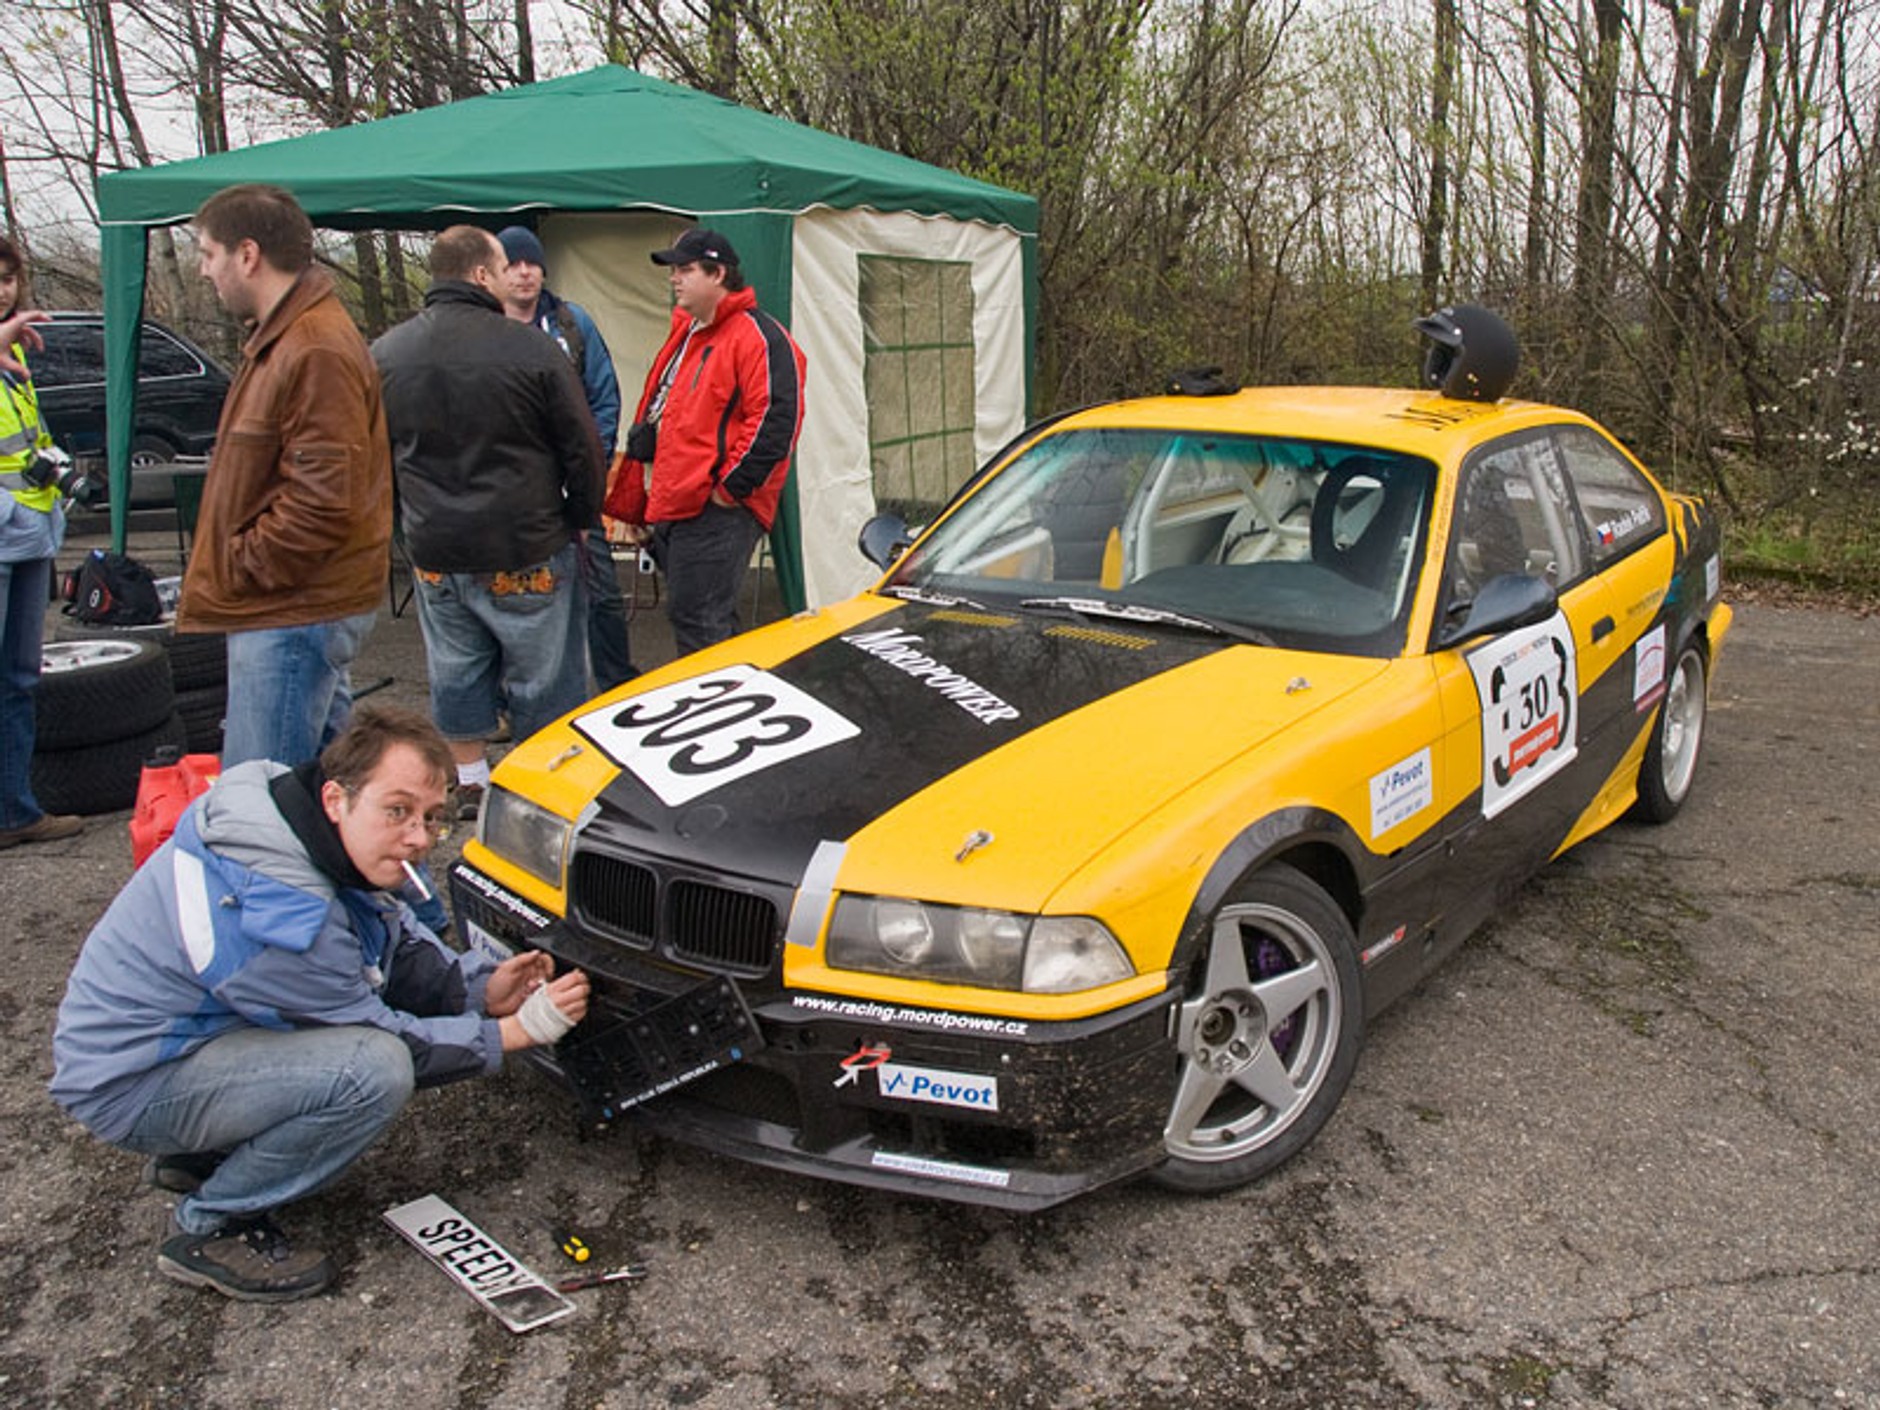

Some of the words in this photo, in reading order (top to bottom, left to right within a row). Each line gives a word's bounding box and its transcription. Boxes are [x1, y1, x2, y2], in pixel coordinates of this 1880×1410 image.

[612, 679, 812, 775] 303
[793, 995, 1029, 1036] www.racing.mordpower.cz
[912, 1076, 993, 1105] Pevot
